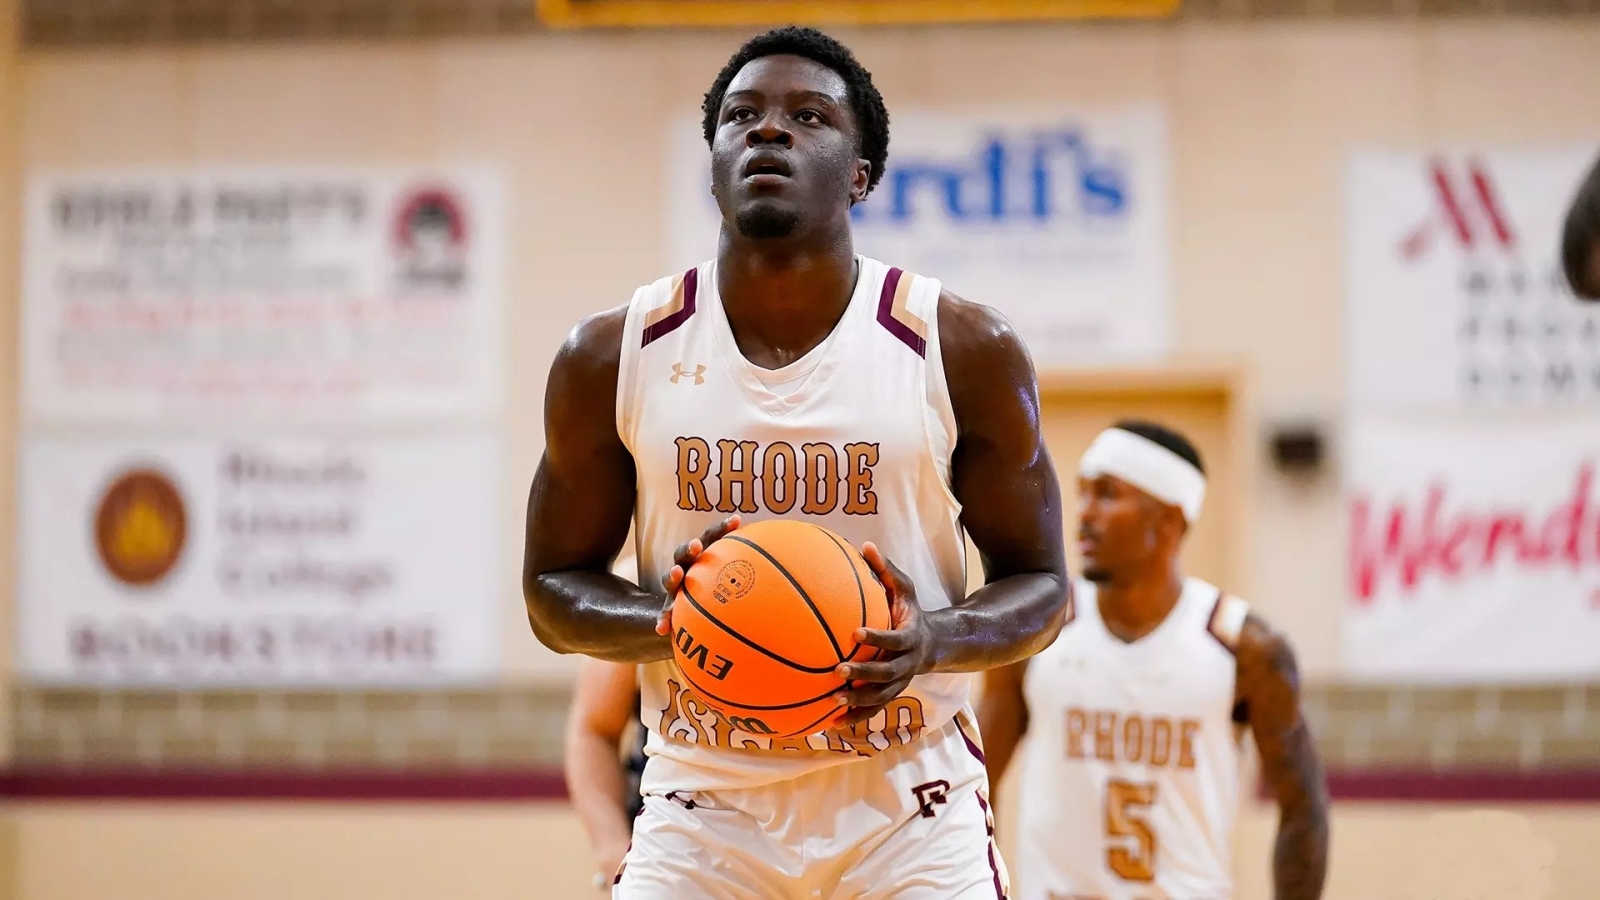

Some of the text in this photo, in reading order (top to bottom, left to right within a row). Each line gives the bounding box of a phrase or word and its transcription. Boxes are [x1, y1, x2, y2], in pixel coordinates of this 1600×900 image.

[674, 436, 880, 515] RHODE
[1065, 706, 1200, 768] RHODE
[1104, 780, 1158, 882] 5
